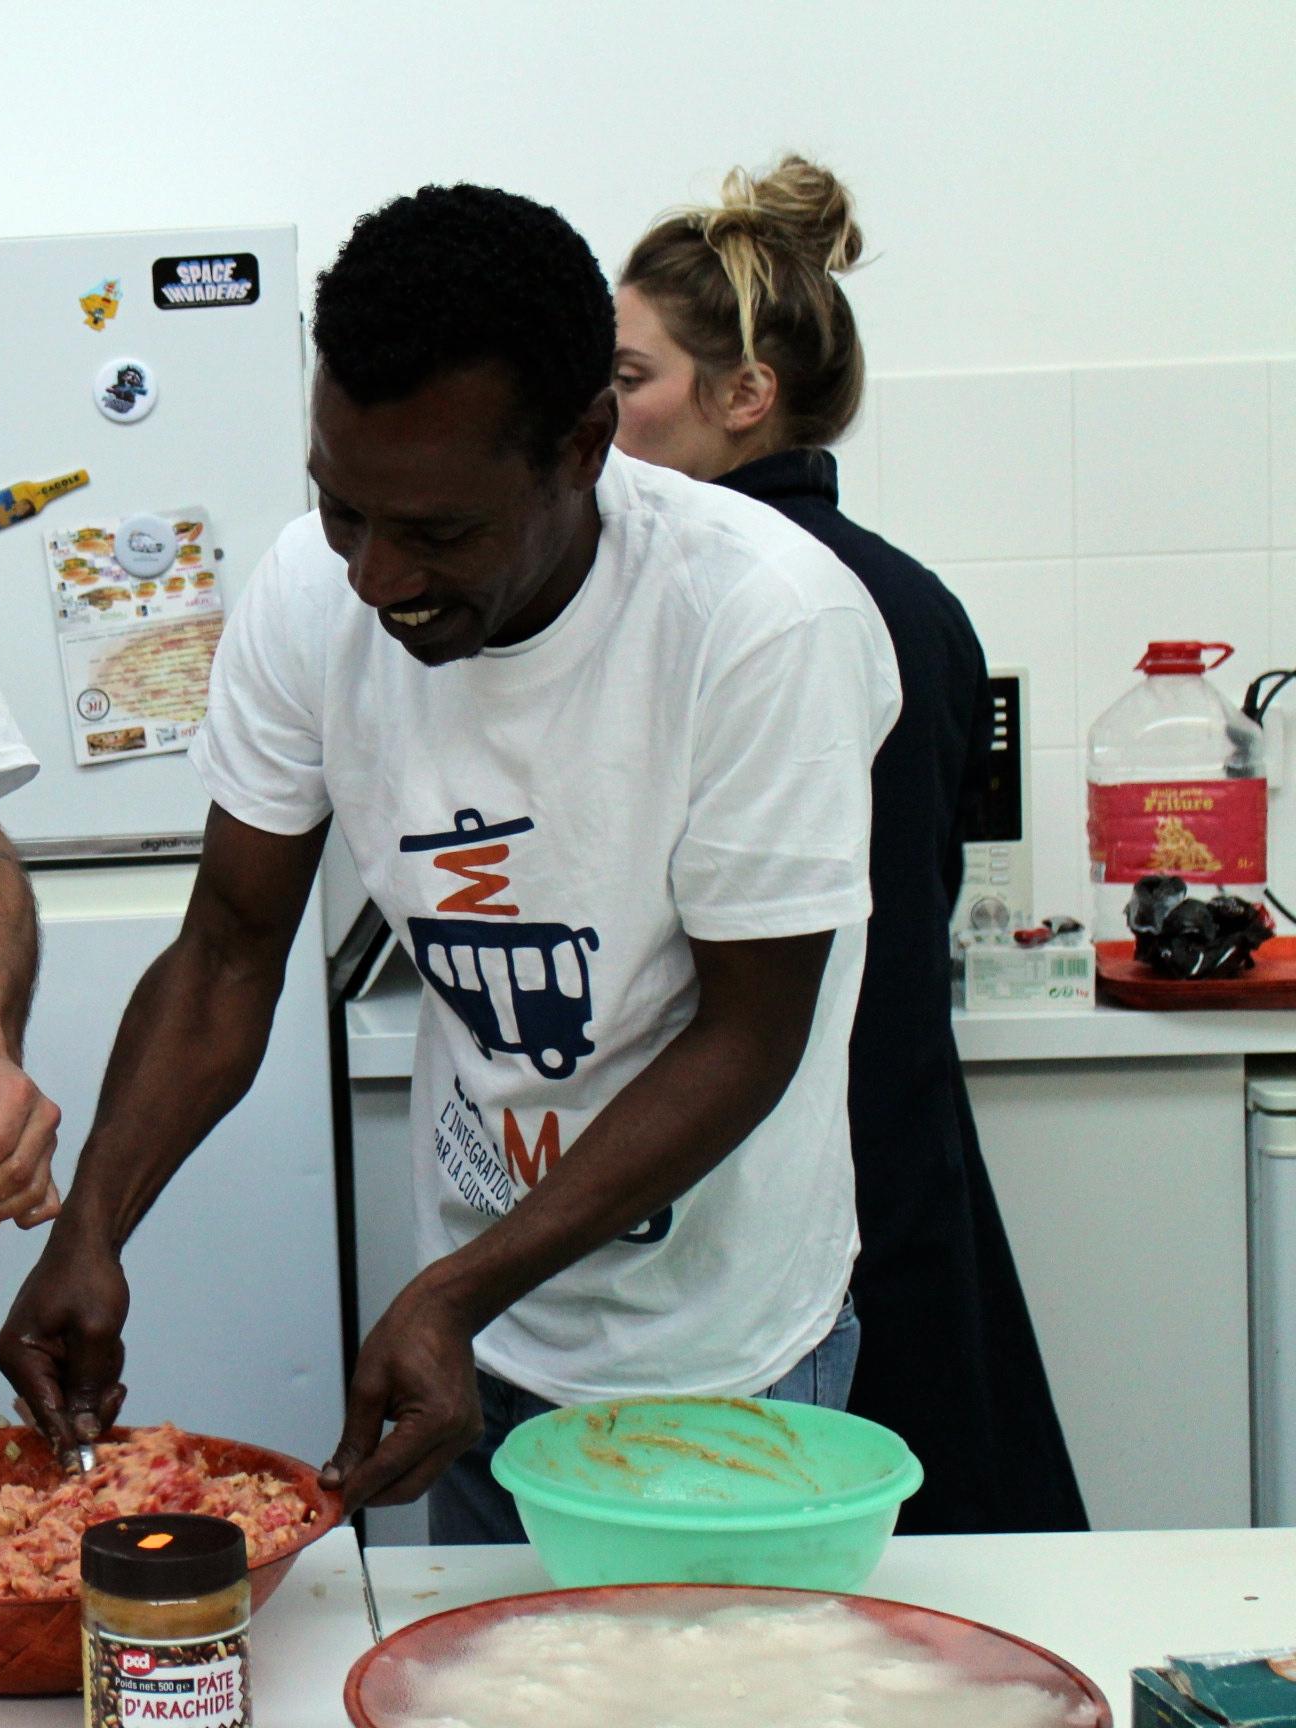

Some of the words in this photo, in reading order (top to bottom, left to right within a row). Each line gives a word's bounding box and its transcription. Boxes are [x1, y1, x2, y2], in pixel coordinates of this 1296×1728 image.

[176, 259, 237, 284] SPACE
[161, 279, 252, 303] INVADERS
[1144, 796, 1214, 812] Friture
[440, 1100, 514, 1211] L'INTÉGRATION
[447, 1152, 461, 1182] LA
[115, 1677, 138, 1689] Poids
[158, 1682, 174, 1691] 500
[176, 1682, 182, 1693] g
[197, 1670, 234, 1695] PÂTE
[124, 1692, 235, 1720] D'ARACHIDE
